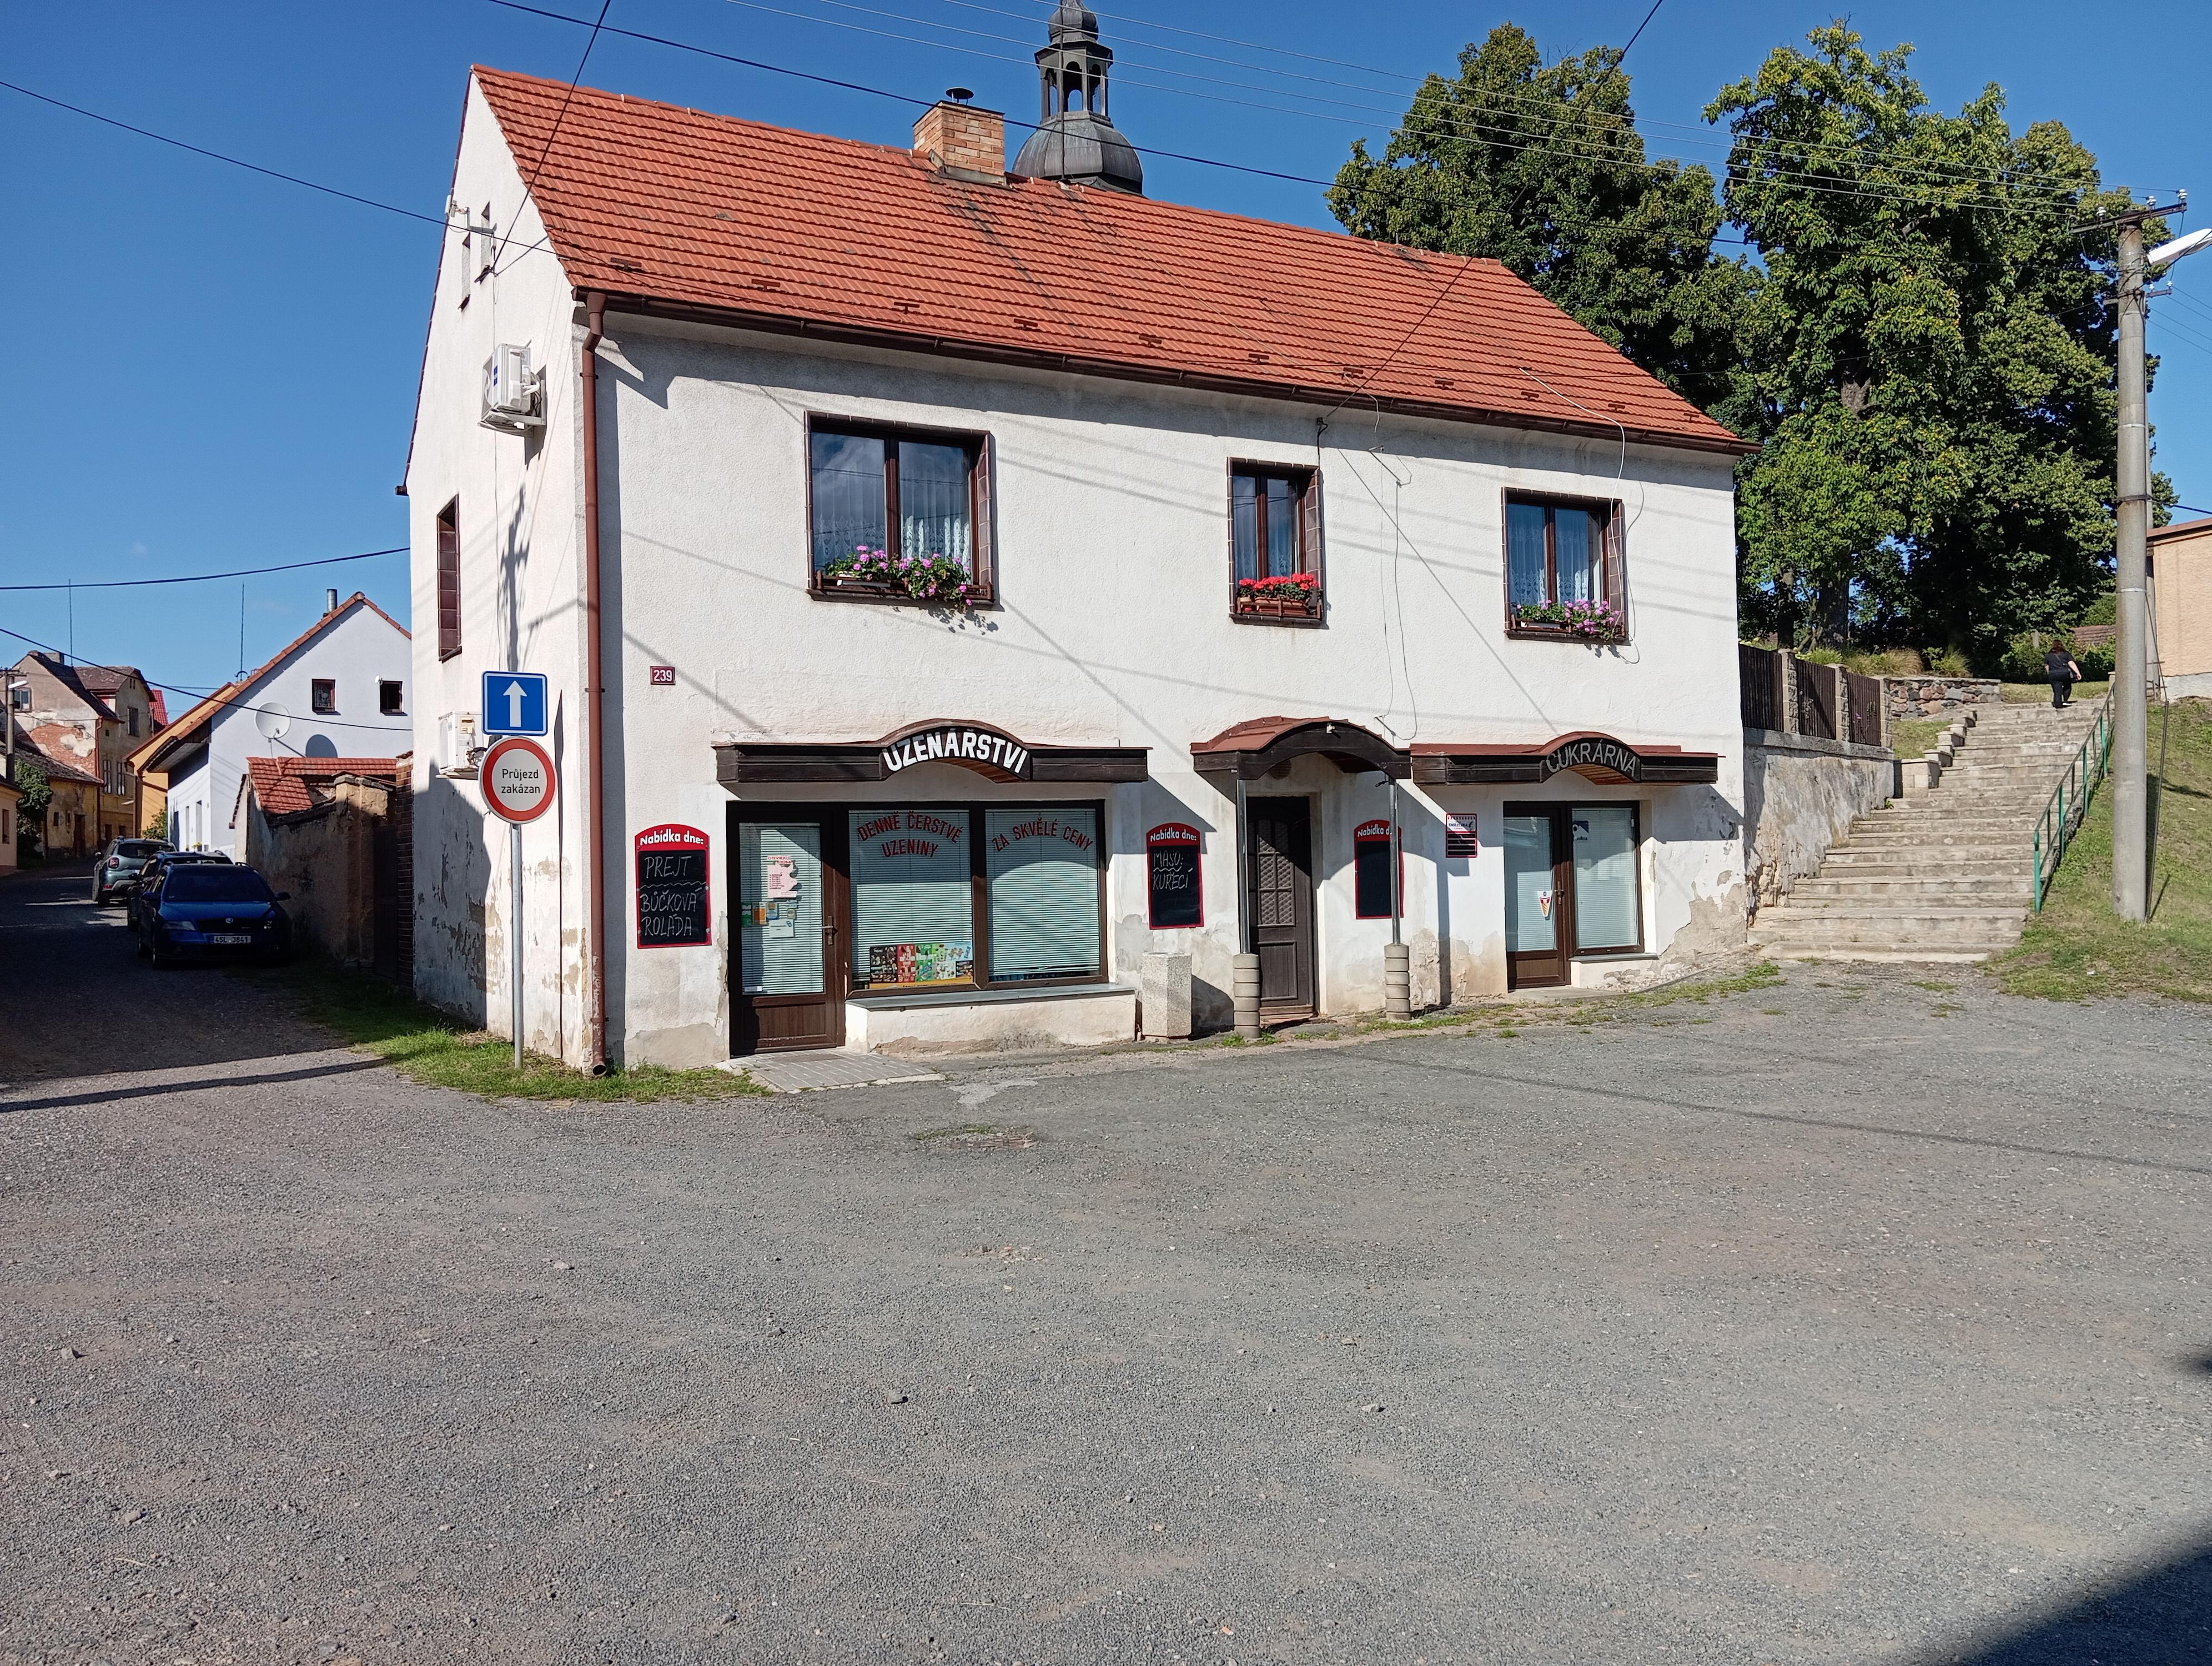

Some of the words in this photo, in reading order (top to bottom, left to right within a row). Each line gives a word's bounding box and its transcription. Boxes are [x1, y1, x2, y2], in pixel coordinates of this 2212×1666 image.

[653, 669, 672, 681] 239
[1546, 739, 1637, 777] CUKRÁRNA
[502, 769, 539, 781] Průjezd
[501, 784, 541, 794] zakázan
[857, 811, 902, 841] DENNĚ
[907, 810, 964, 844] ČERSTVÉ
[991, 833, 1011, 852] ZA
[1012, 817, 1059, 840] SKVĚLÉ
[1062, 826, 1094, 851] CENY
[1150, 827, 1180, 842] Nabídka
[1182, 829, 1197, 841] dne:
[1358, 824, 1384, 837] Nabídka
[640, 828, 681, 846] Nabídka
[683, 830, 704, 845] dne:
[881, 839, 938, 858] UZENINY
[644, 856, 692, 879] PREJT
[1153, 850, 1184, 867] MASO:
[1153, 867, 1193, 890] KUŘECÍ
[641, 914, 692, 937] ROLÁDA
